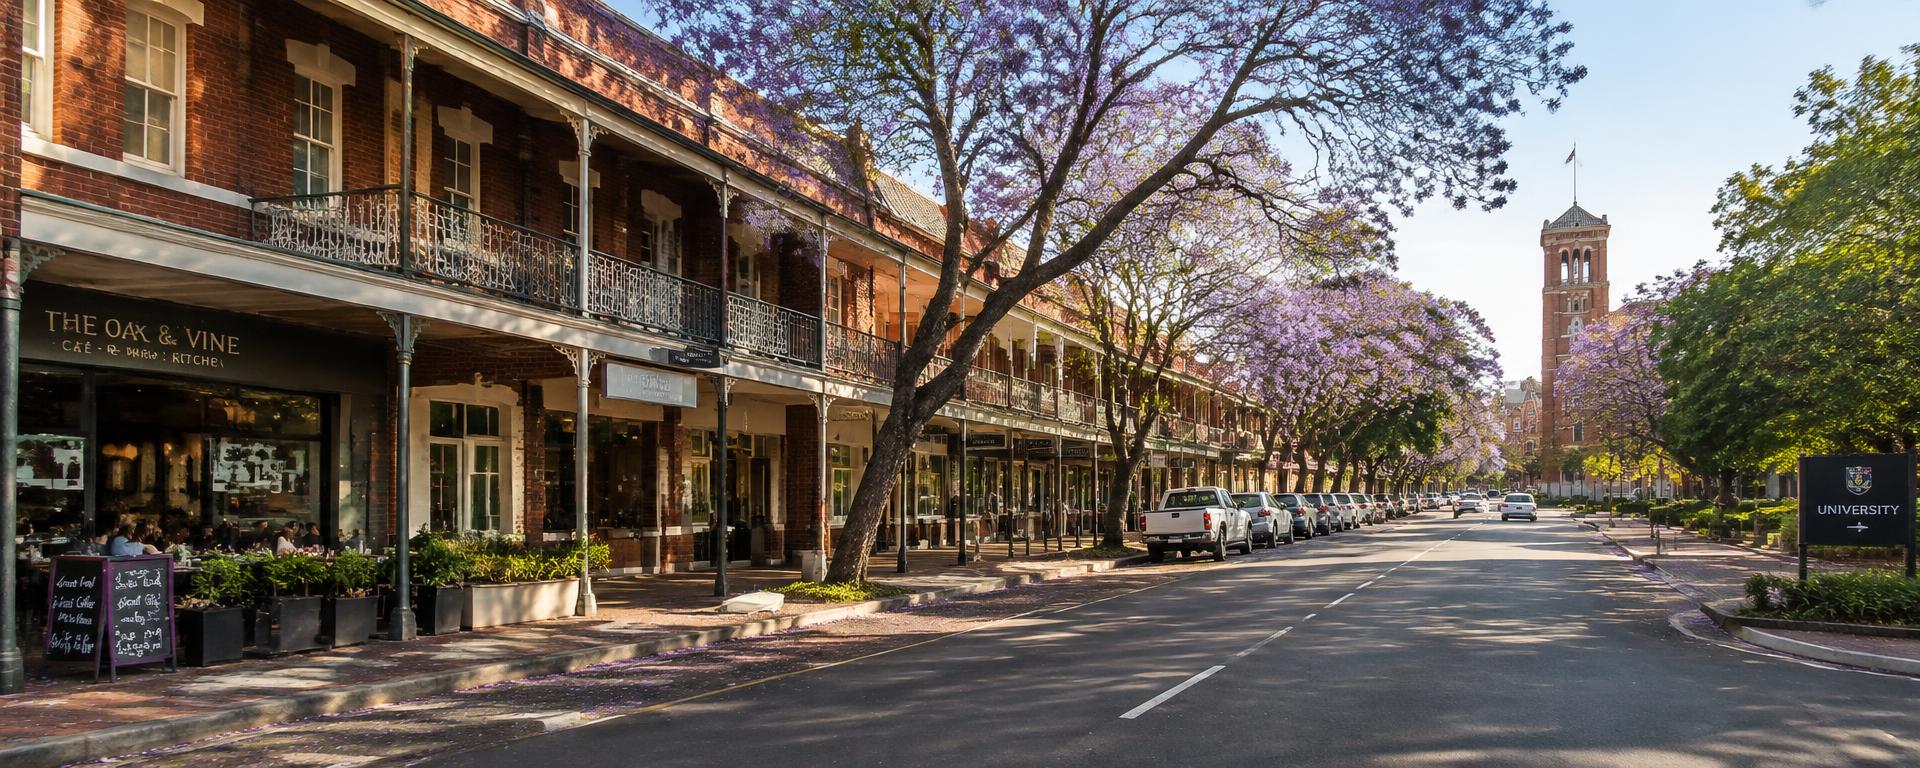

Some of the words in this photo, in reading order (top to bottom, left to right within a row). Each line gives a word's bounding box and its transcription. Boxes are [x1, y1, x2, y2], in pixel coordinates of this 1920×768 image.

[45, 310, 97, 336] THE
[105, 319, 150, 343] OAK
[158, 324, 177, 346] &
[186, 328, 240, 355] VINE
[1817, 505, 1900, 515] UNIVERSITY
